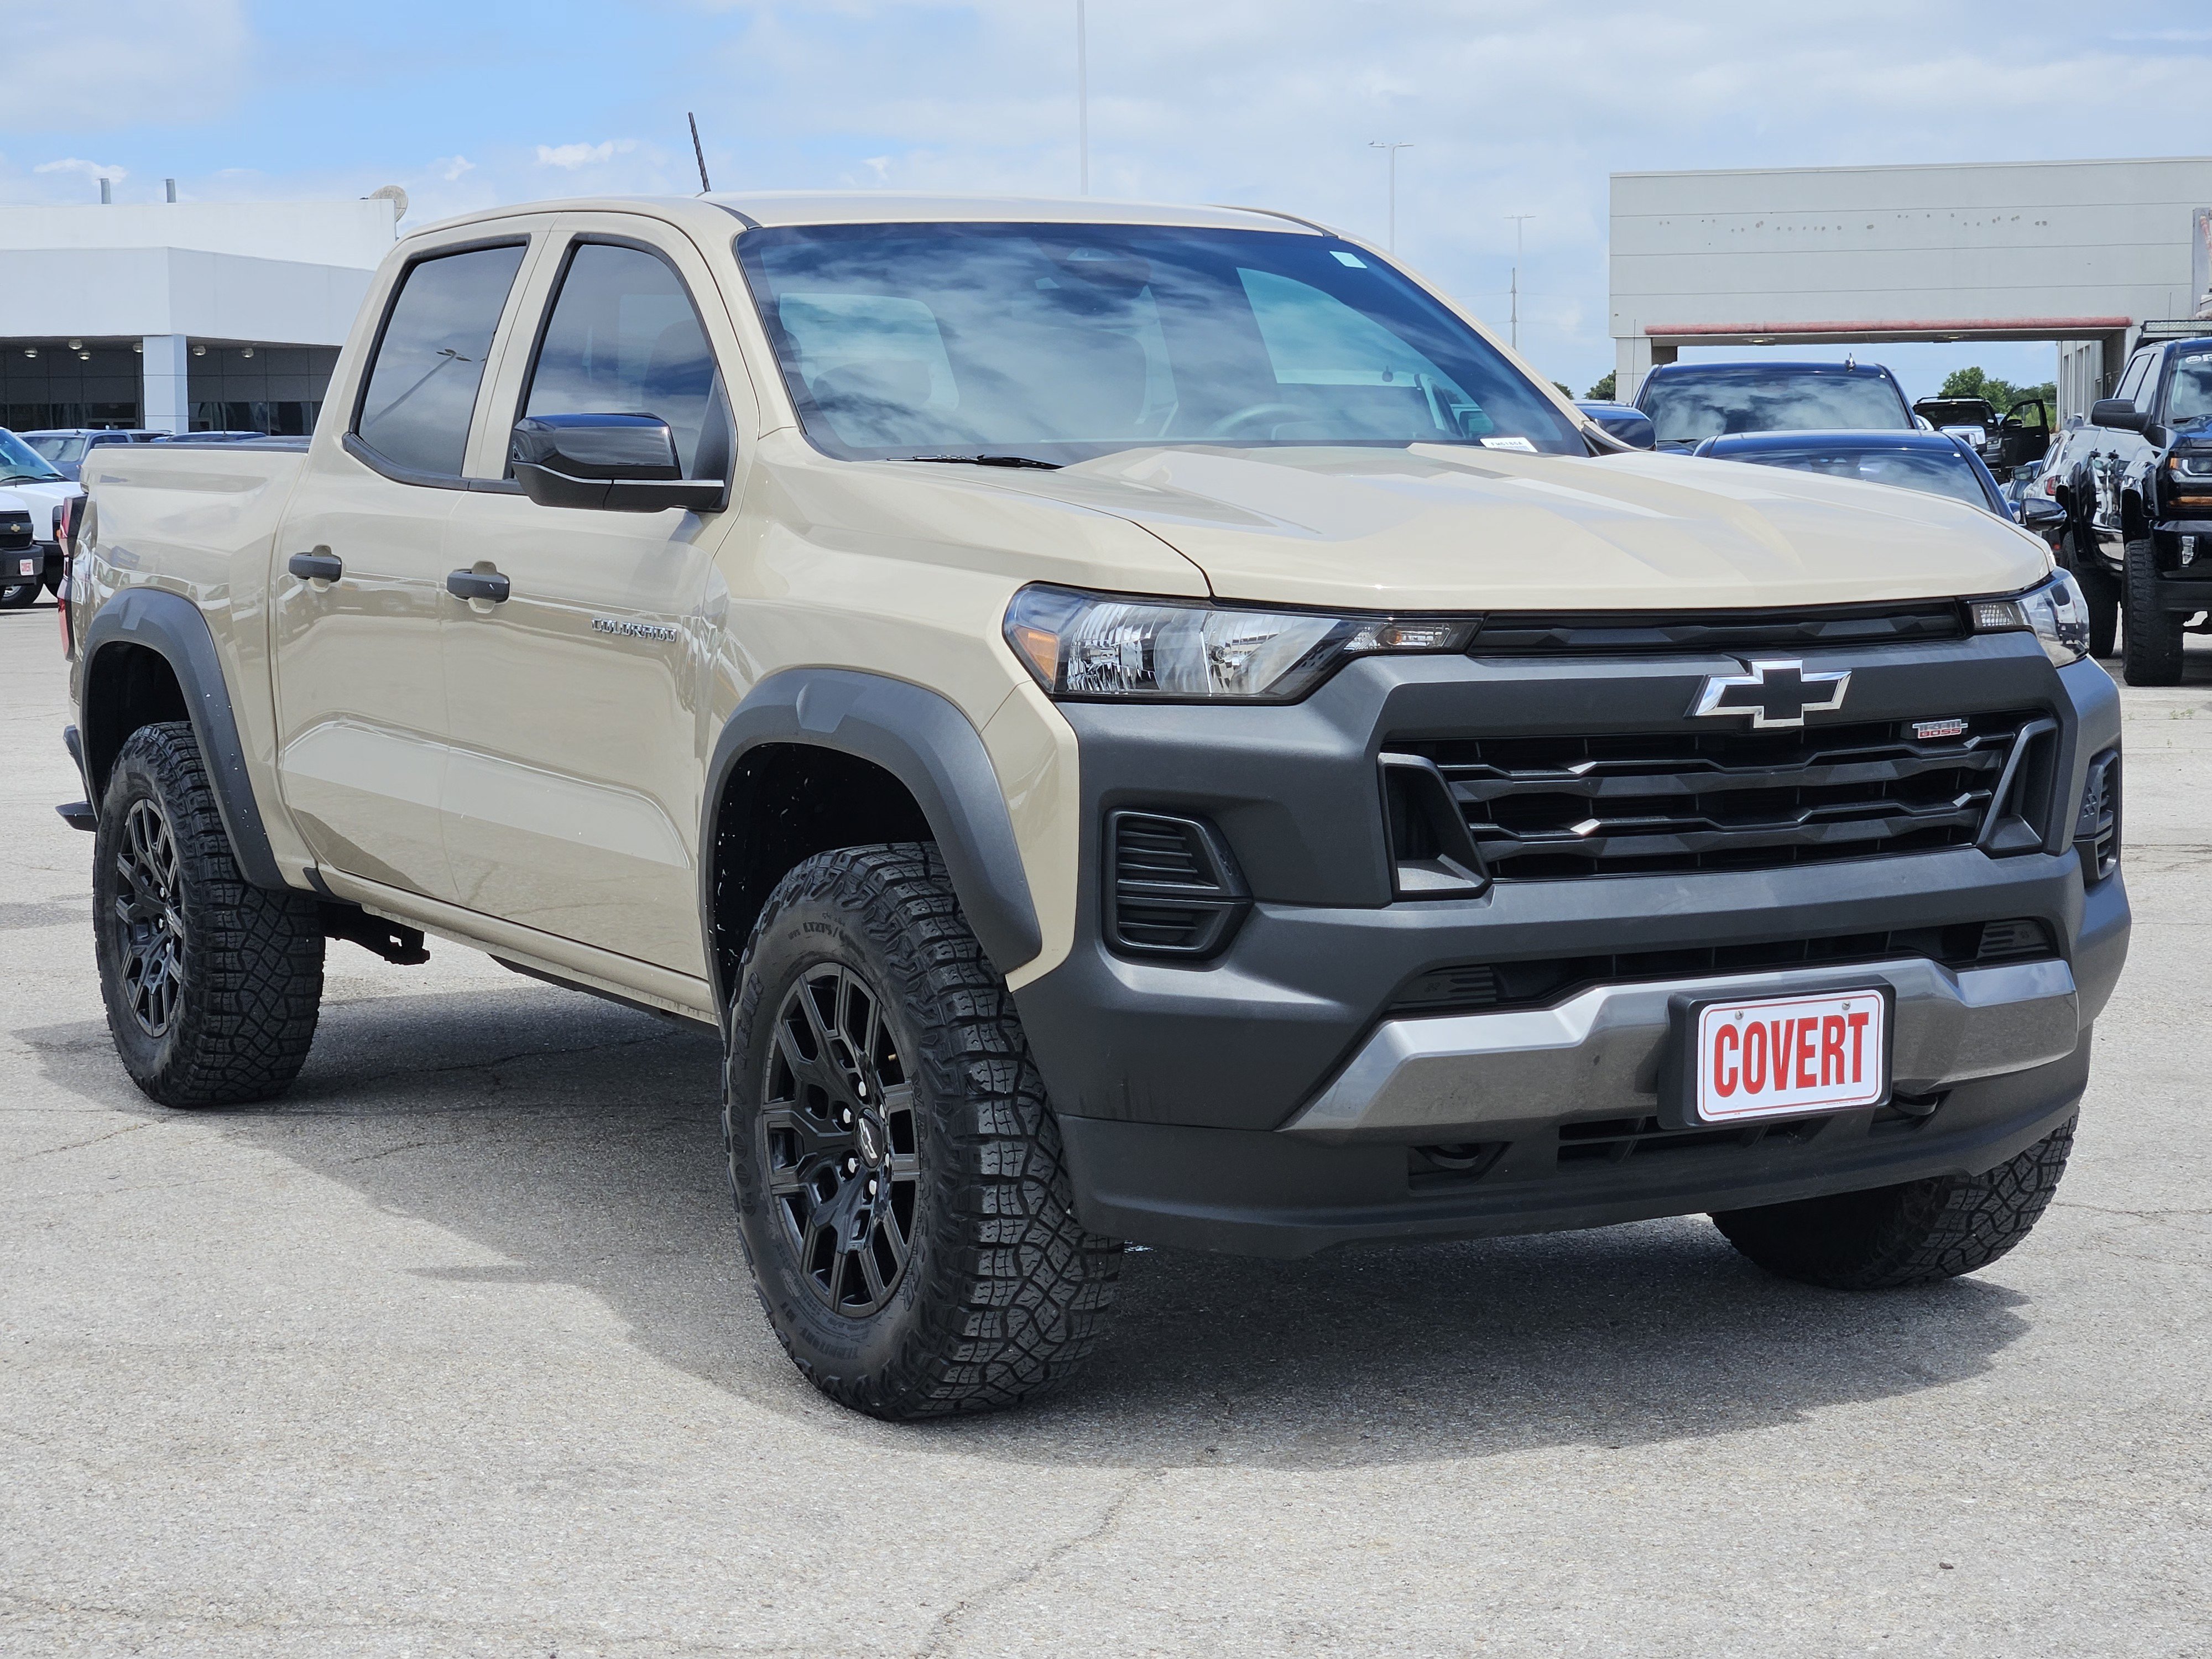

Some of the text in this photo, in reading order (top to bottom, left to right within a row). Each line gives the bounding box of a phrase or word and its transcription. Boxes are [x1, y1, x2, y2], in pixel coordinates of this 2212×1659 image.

[592, 618, 677, 642] COLORADO
[1913, 719, 1968, 731] TRAIL
[1919, 728, 1960, 737] BOSS
[1715, 1012, 1869, 1098] COVERT
[729, 971, 765, 1215] GOODYEAR
